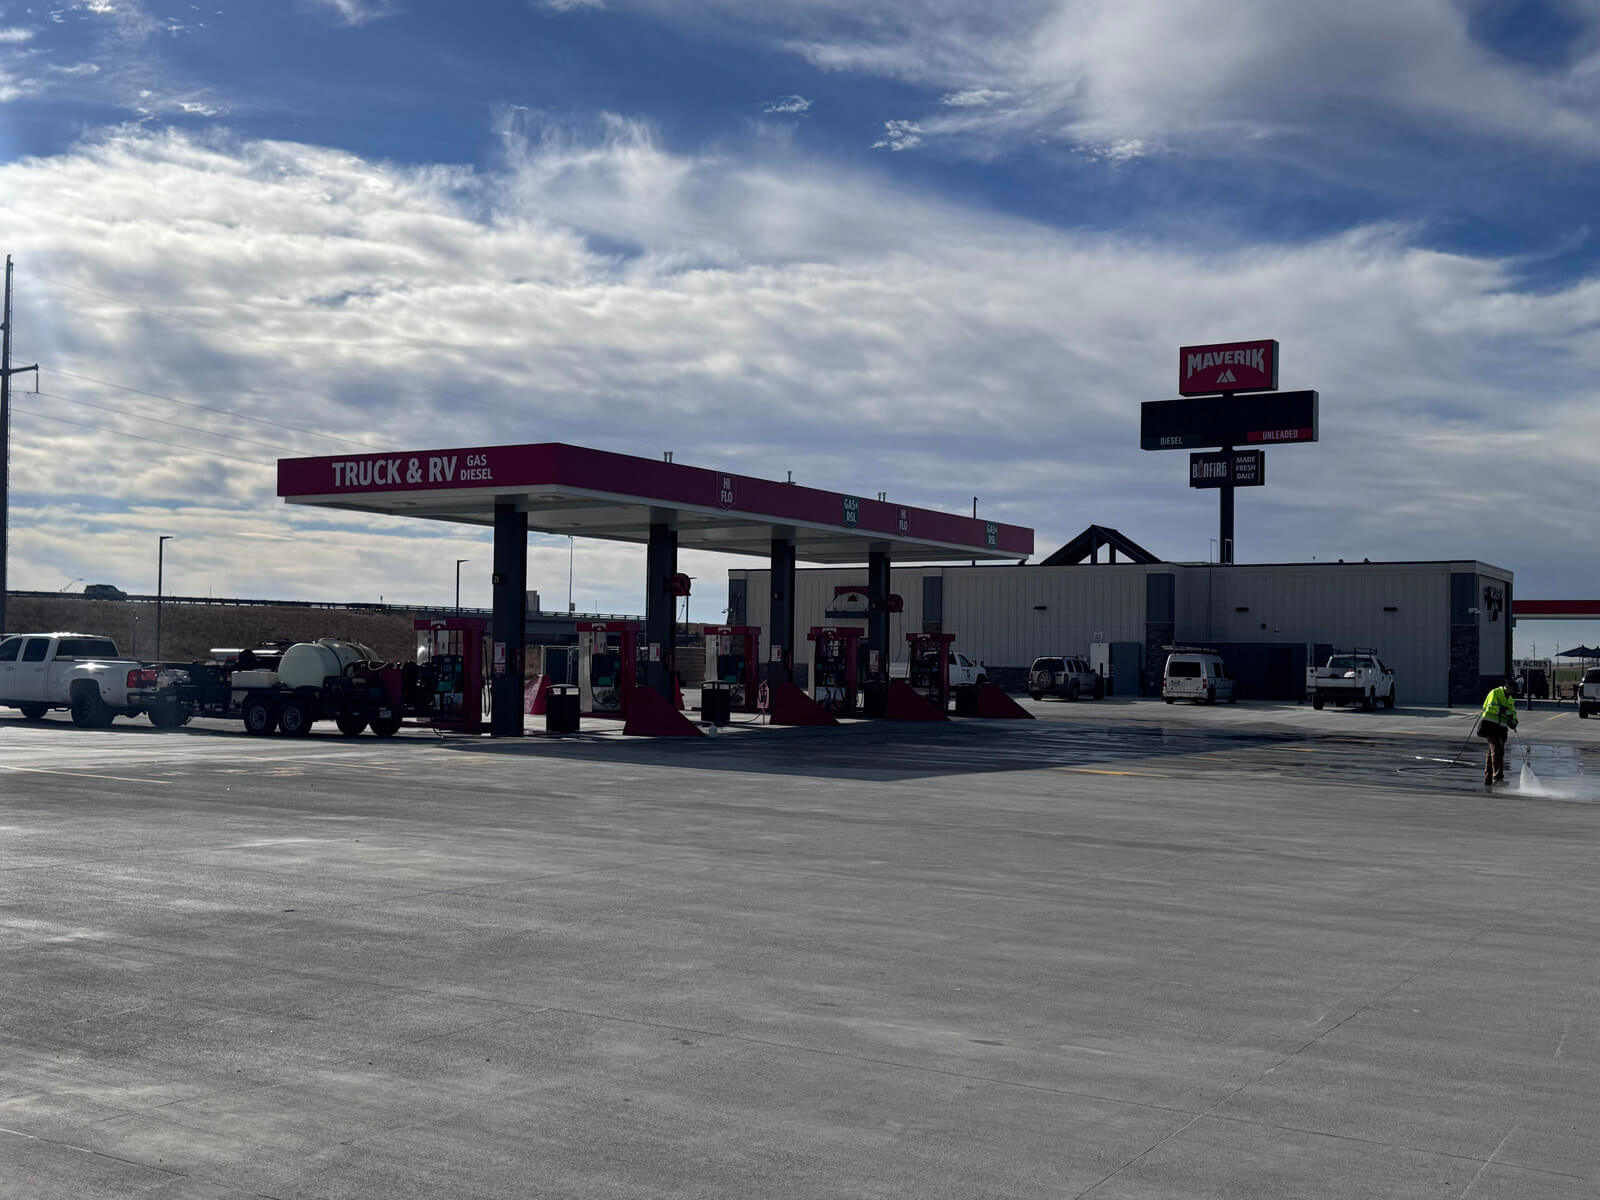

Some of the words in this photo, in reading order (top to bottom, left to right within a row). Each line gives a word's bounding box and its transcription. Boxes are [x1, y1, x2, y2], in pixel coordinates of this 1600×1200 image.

[1187, 347, 1265, 380] MAVERIK
[1160, 436, 1183, 446] DIESEL
[1262, 429, 1298, 440] UNLEADED
[467, 454, 487, 467] GAS
[331, 459, 402, 487] TRUCK
[406, 457, 423, 484] &
[429, 456, 457, 482] RV
[460, 468, 493, 481] DIESEL
[720, 490, 733, 503] FLO
